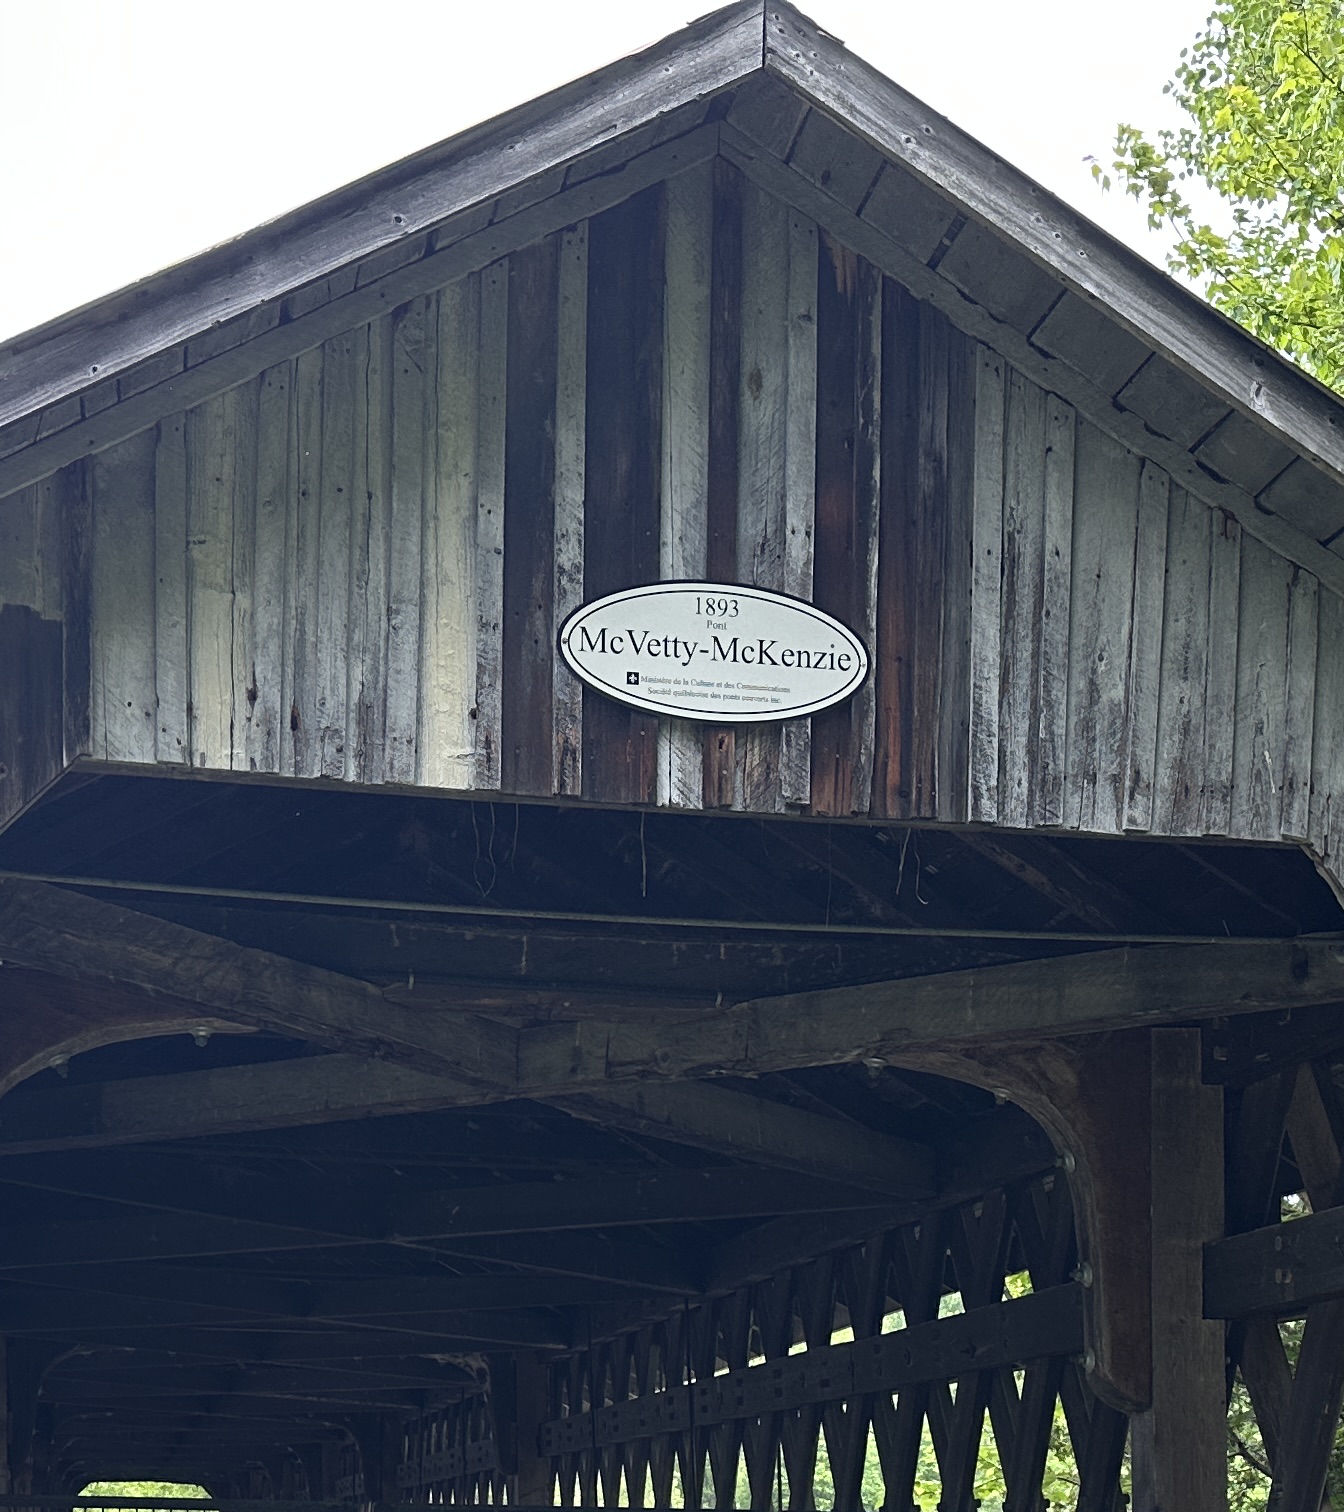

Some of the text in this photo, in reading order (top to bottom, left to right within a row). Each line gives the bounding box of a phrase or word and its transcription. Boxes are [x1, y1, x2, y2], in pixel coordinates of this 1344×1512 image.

[695, 596, 739, 618] 1893
[706, 619, 727, 630] Pont
[578, 626, 851, 672] McVetty-McKenzie
